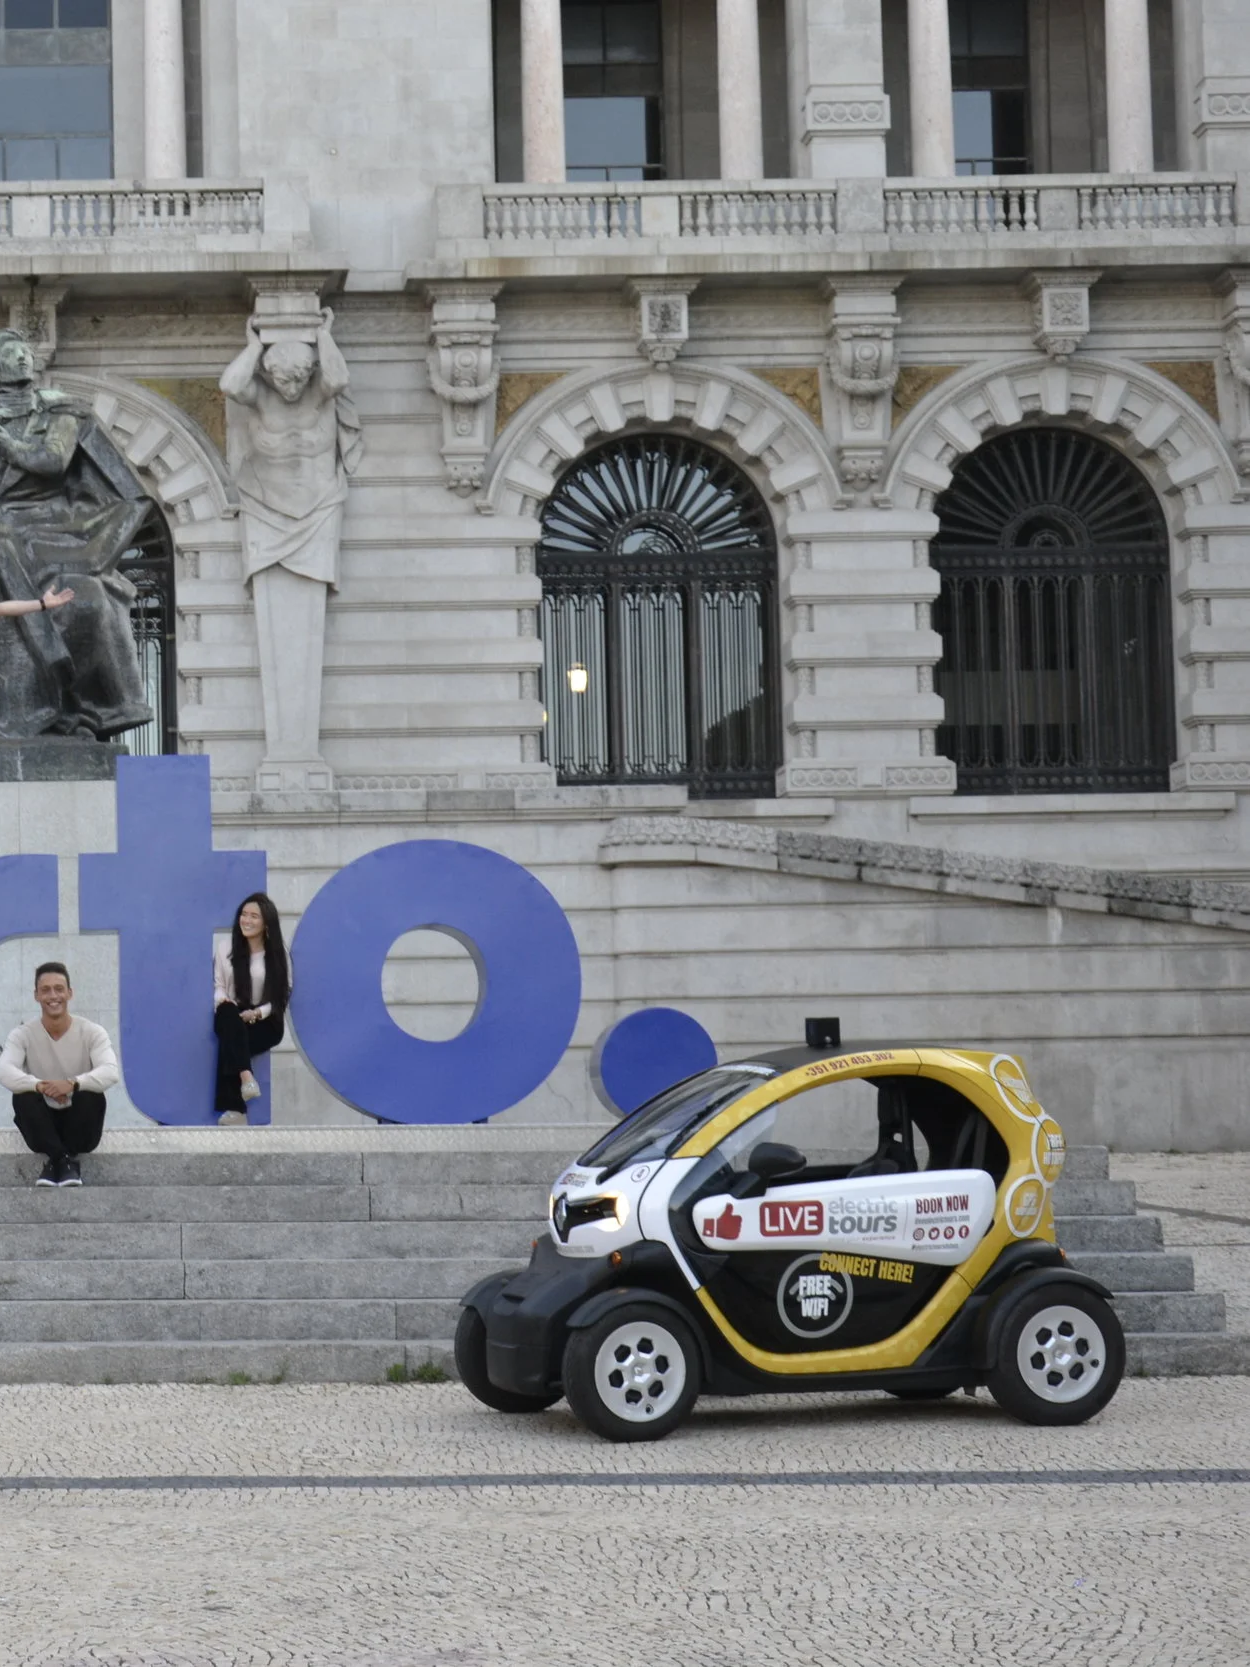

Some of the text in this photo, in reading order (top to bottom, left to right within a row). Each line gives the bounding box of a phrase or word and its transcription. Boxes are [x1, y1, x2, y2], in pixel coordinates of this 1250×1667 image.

[829, 1059, 850, 1071] 921
[851, 1055, 872, 1065] 453
[873, 1051, 895, 1061] 302
[828, 1196, 899, 1214] electric
[915, 1194, 969, 1214] BOOK NOW
[764, 1205, 819, 1232] LIVE
[828, 1215, 898, 1234] tours
[819, 1252, 915, 1283] CONNECT HERE!
[798, 1275, 832, 1296] FREE
[801, 1297, 829, 1317] WIFI
